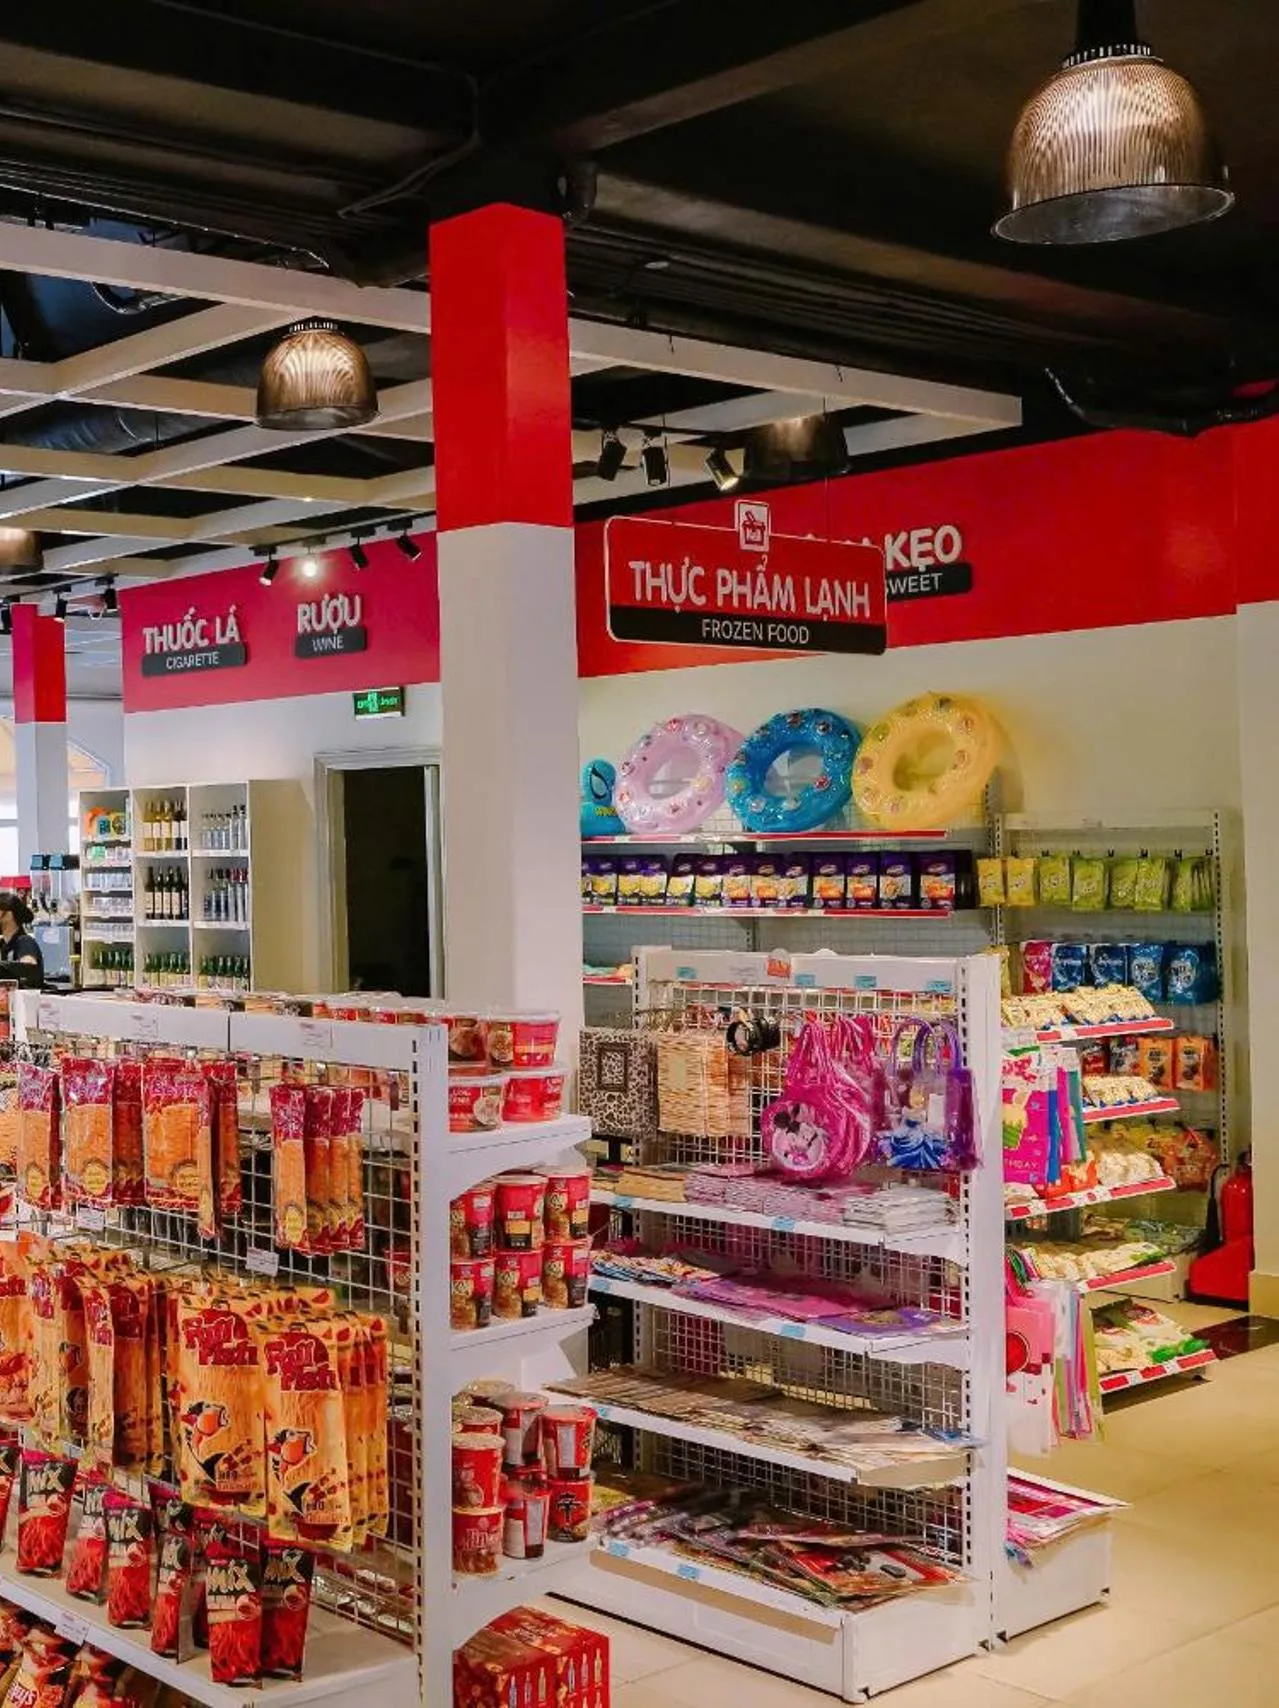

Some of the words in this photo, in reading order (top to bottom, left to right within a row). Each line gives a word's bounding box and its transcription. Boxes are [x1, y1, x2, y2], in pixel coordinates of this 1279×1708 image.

[884, 524, 963, 573] KẸO
[628, 556, 707, 614] THỰC
[715, 554, 797, 615] PHẨM
[804, 576, 871, 623] LẠNH
[886, 572, 944, 595] WEET
[141, 605, 210, 655] THUỐC
[215, 603, 241, 646] LÁ
[297, 592, 362, 635] RƯỢU
[312, 636, 345, 653] WINE
[701, 618, 764, 642] FROZEN
[767, 624, 810, 645] FOOD
[166, 650, 220, 671] CIGARETTE
